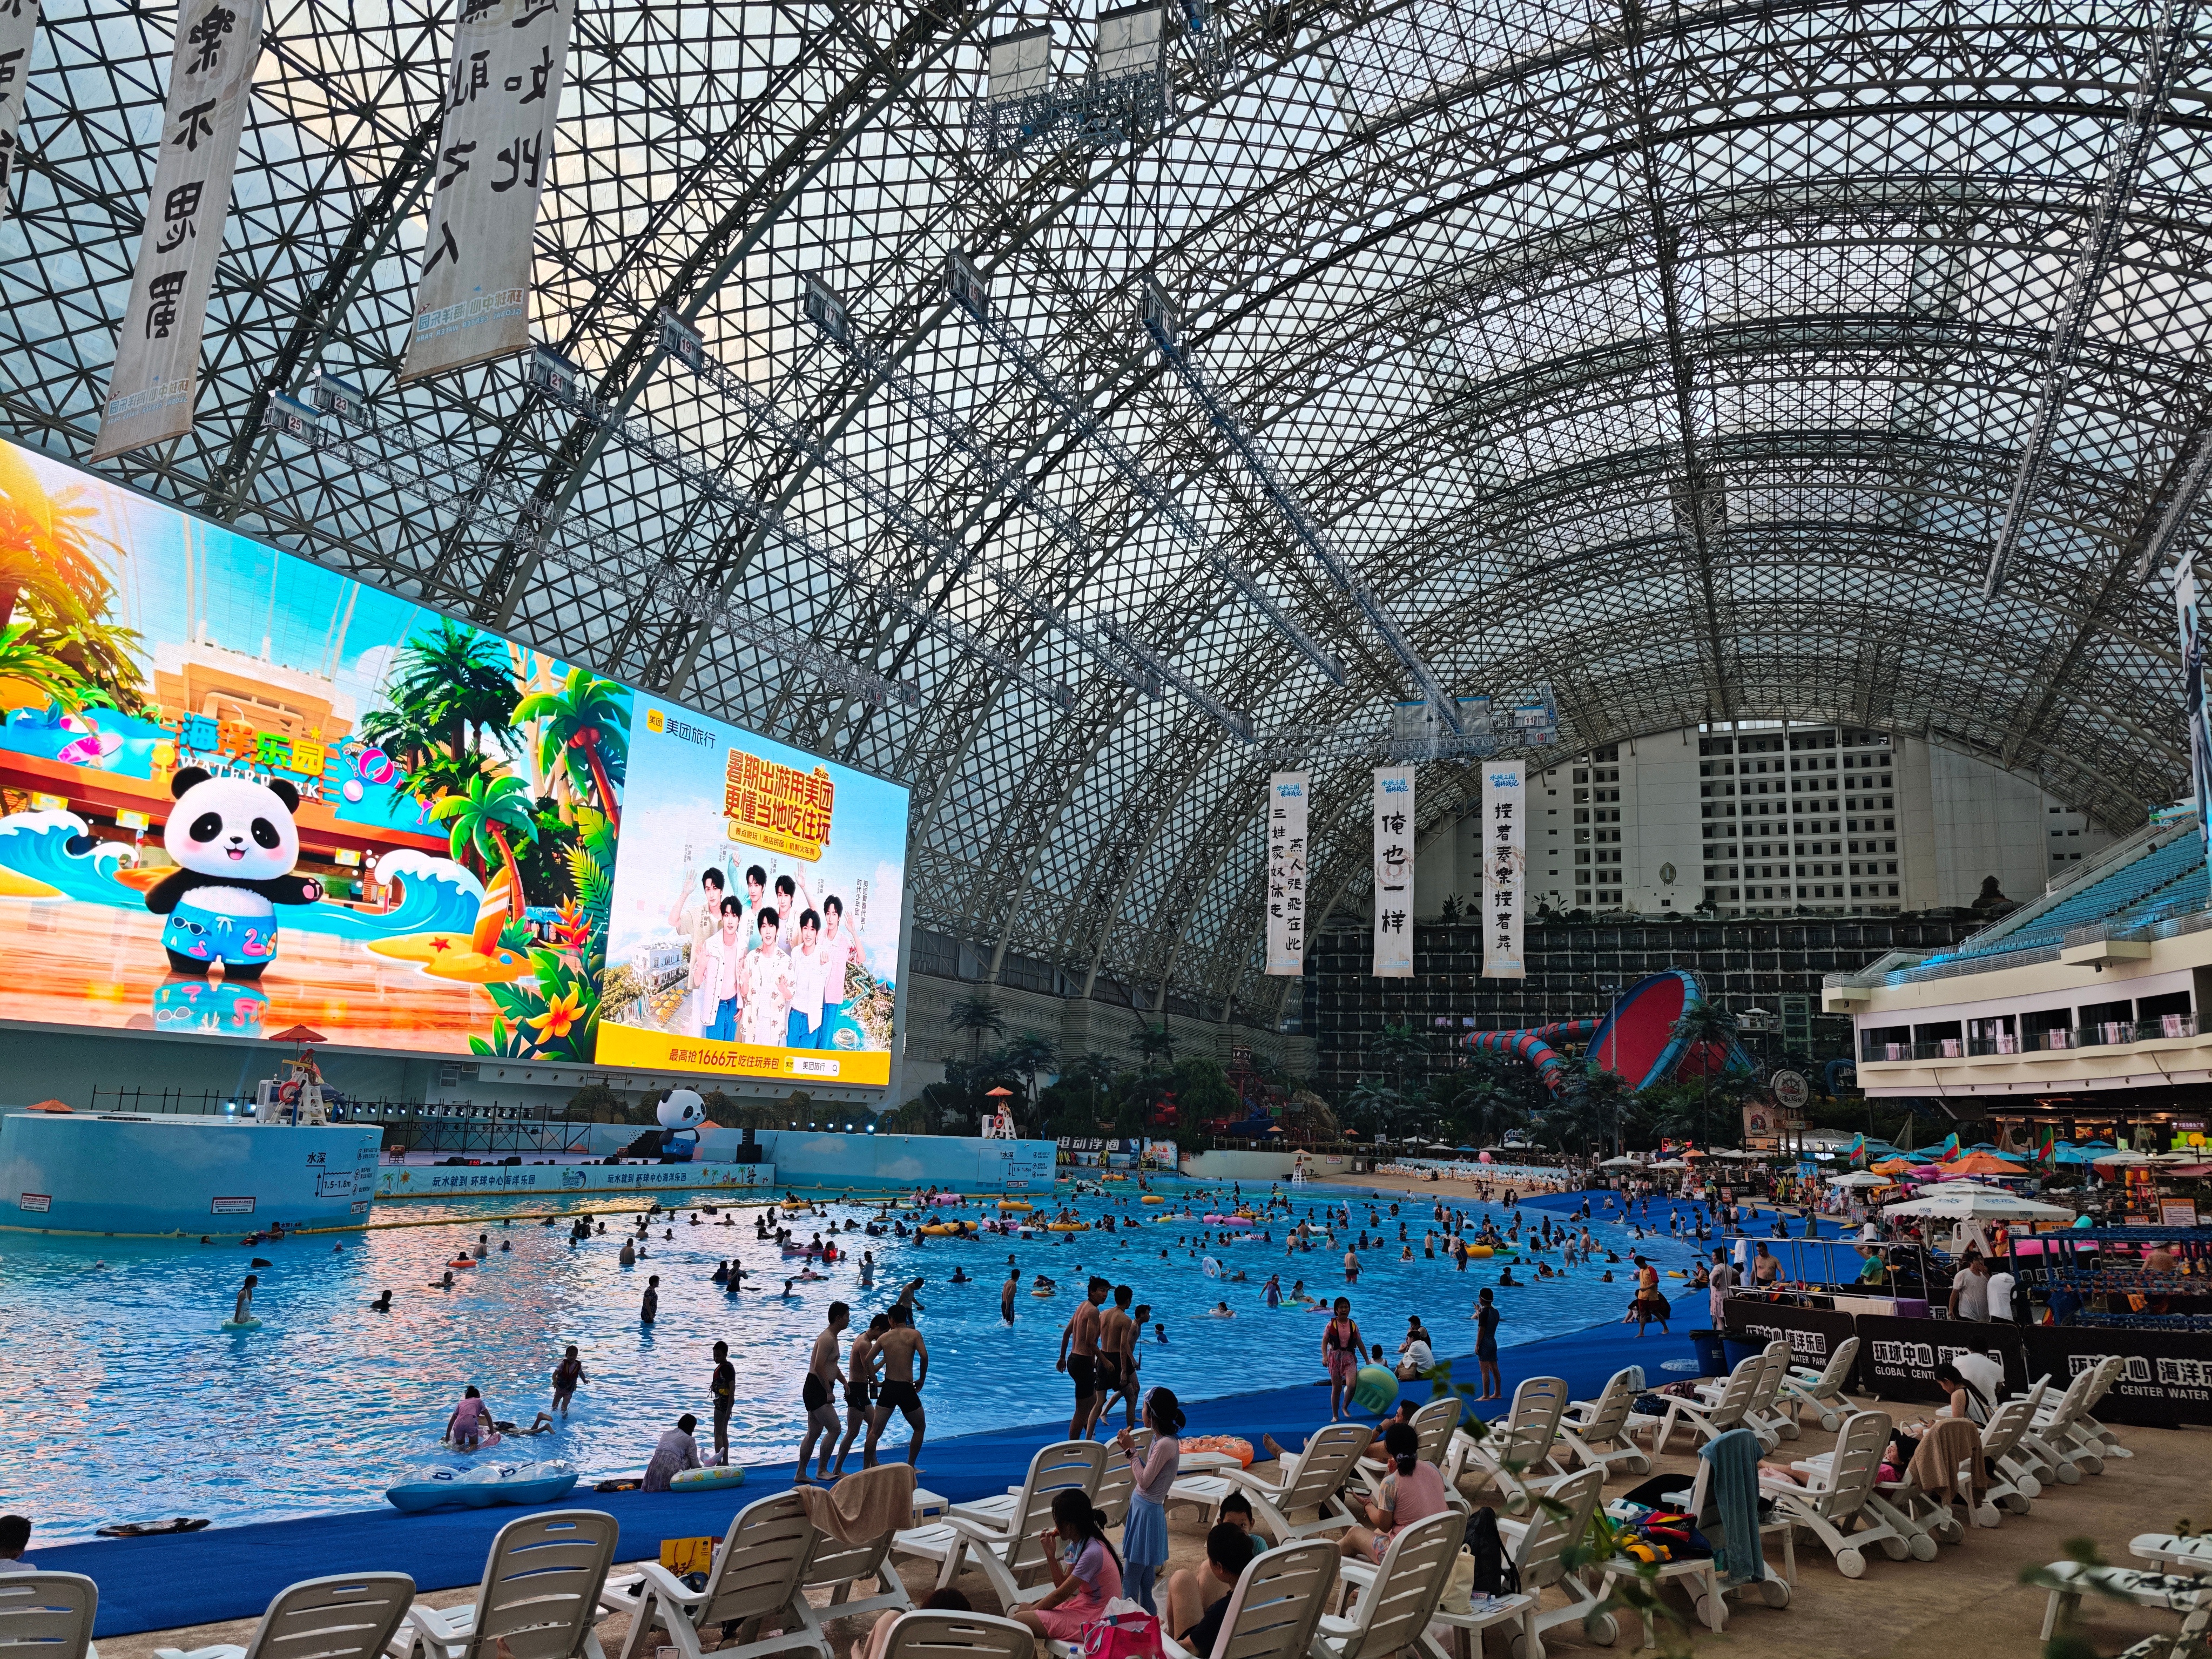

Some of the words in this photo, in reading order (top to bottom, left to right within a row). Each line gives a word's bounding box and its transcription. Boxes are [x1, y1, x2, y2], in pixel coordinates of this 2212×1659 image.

[827, 306, 835, 322] 17
[682, 338, 692, 354] 19
[552, 373, 563, 389] 21
[336, 397, 347, 410] 23
[289, 417, 301, 430] 25
[649, 716, 662, 727] 美团
[666, 718, 716, 749] 美团旅行
[179, 712, 325, 776] 海洋乐园
[727, 748, 834, 813] 暑期出游用美团
[1381, 778, 1406, 786] 水域三国
[1489, 772, 1515, 781] 水域三国
[1493, 780, 1519, 788] 萌将战记
[260, 773, 320, 799] PRK
[1276, 783, 1299, 791] 水域三国
[1280, 789, 1303, 797] 萌将战记
[1385, 785, 1409, 794] 萌将战记
[723, 783, 831, 846] 更懂当地吃住玩
[735, 827, 758, 841] 景点游玩
[763, 835, 785, 848] 酒店民宿
[789, 842, 815, 857] 机票火车票
[1270, 809, 1286, 918] 三姓家奴休走
[1381, 811, 1407, 934] 俺也一样
[860, 880, 869, 932] 美团青春代言人
[669, 1048, 779, 1070] 最高抢1666元吃住玩券包
[785, 1061, 794, 1069] 美团
[802, 1061, 826, 1071] 美团旅行
[1057, 1136, 1120, 1151] 电动浮圈
[307, 1151, 326, 1164] 水深
[324, 1180, 351, 1189] 1.5-1.8m
[432, 1175, 468, 1187] 玩水就到
[470, 1175, 536, 1186] 环球中心海洋乐园
[607, 1174, 634, 1183] 玩水就到
[636, 1172, 686, 1183] 环球中心海洋乐园
[1785, 1329, 1826, 1354] 海洋乐园
[1790, 1353, 1809, 1364] WATER
[1812, 1357, 1827, 1366] PARK
[1872, 1341, 1934, 1368] 环球中心
[1875, 1366, 1907, 1378] GLOBAL
[1911, 1369, 1936, 1381] CENT
[2068, 1354, 2152, 1382] 环心
[2120, 1385, 2163, 1398] CENTER
[2168, 1387, 2209, 1401] WATER
